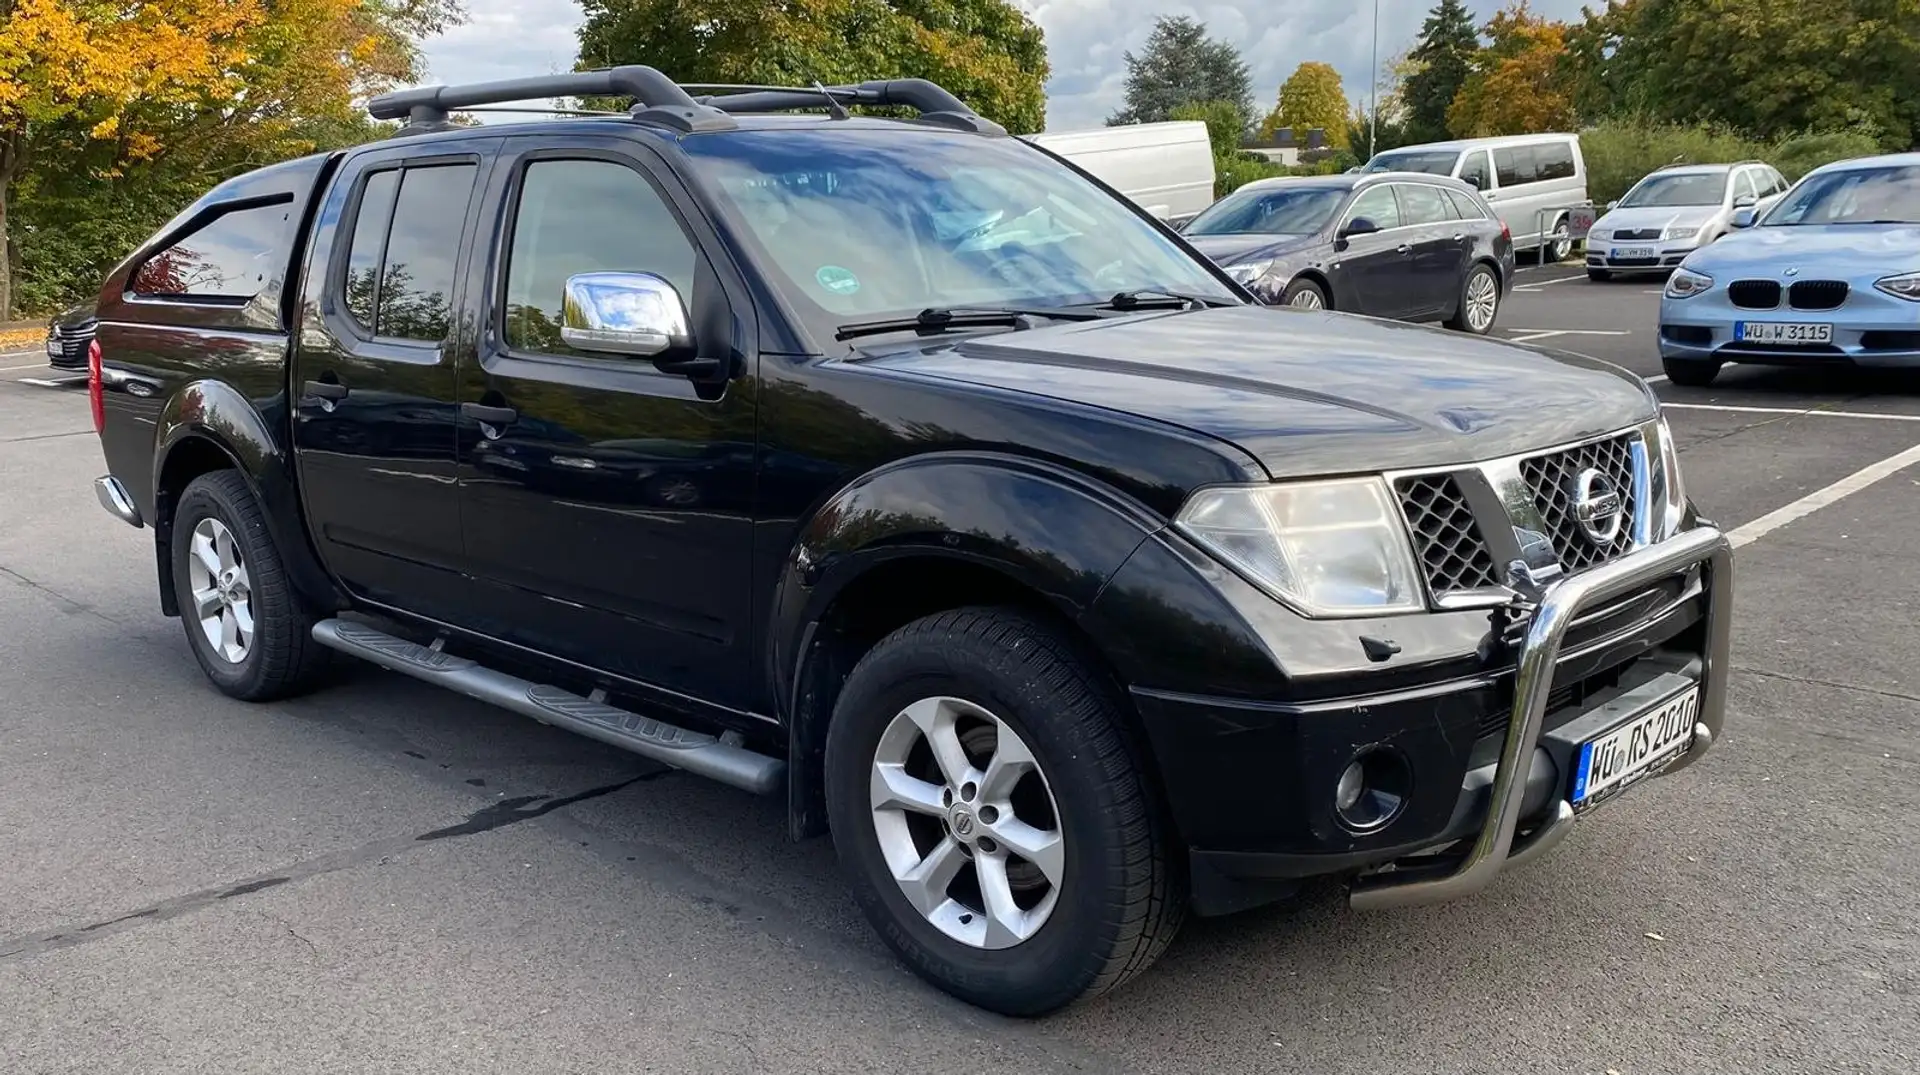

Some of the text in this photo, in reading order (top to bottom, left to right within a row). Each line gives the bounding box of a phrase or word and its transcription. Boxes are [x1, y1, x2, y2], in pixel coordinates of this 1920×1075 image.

[1745, 323, 1829, 340] WÜ W 3115
[1589, 737, 1618, 788] WÜ
[1626, 718, 1653, 768] RS
[1653, 694, 1695, 752] 2010
